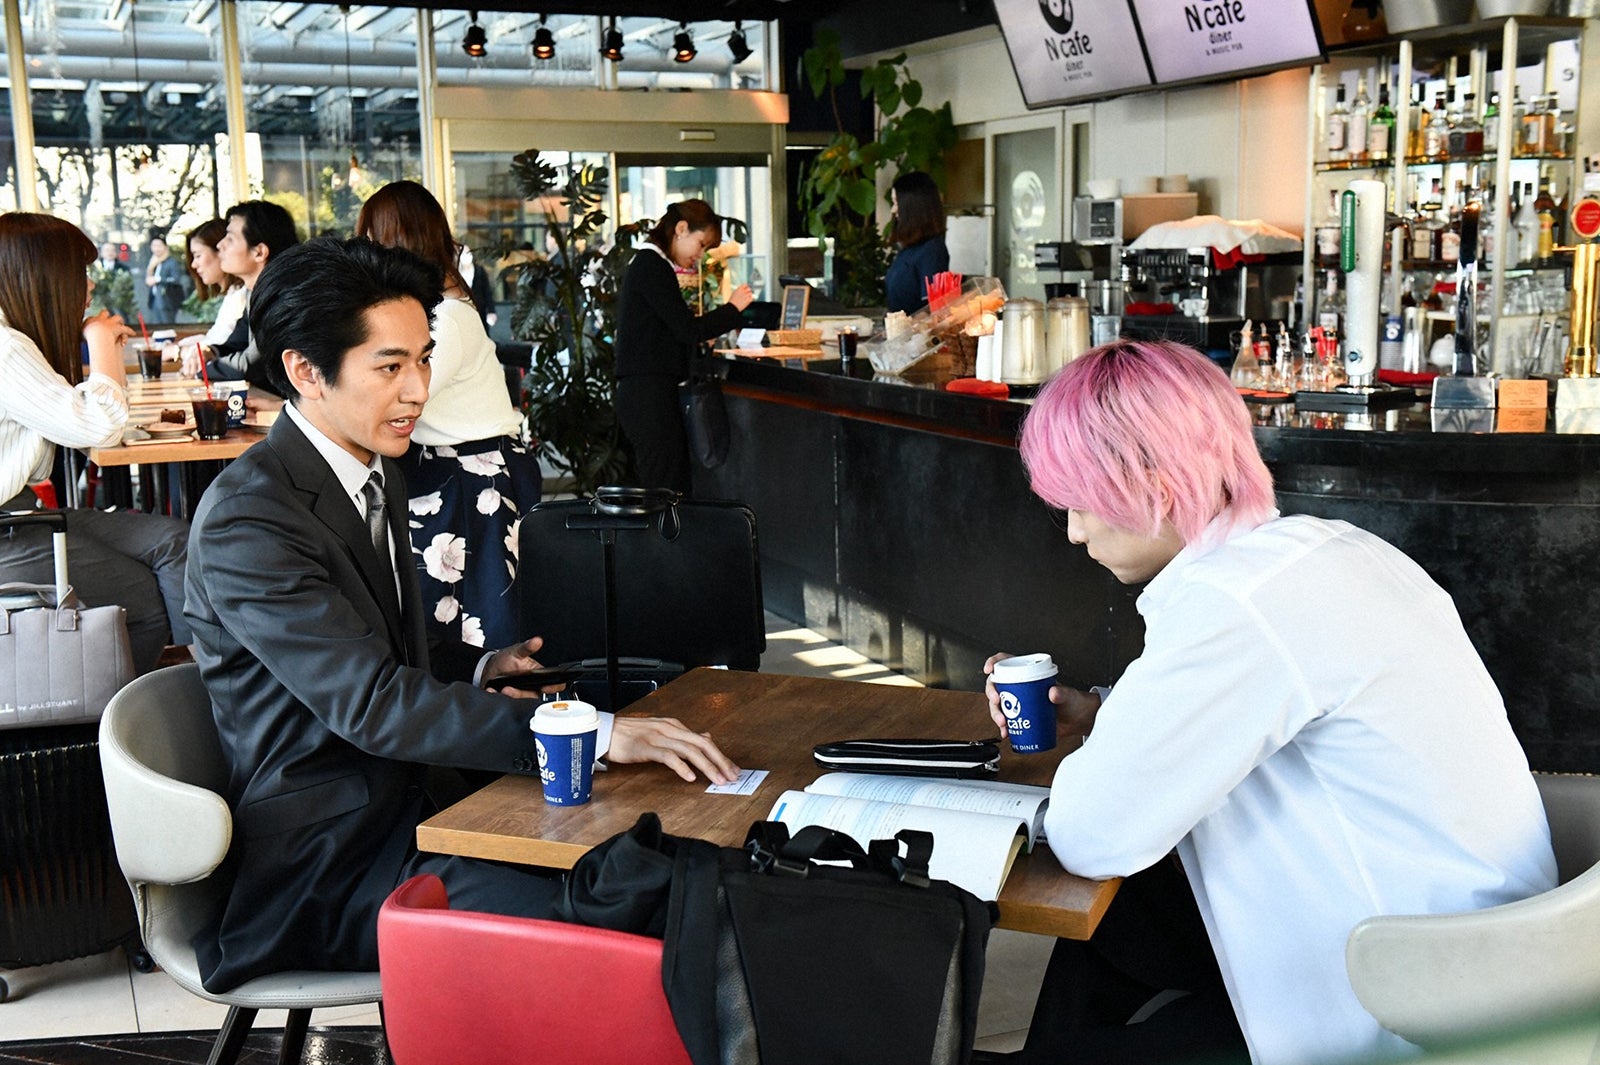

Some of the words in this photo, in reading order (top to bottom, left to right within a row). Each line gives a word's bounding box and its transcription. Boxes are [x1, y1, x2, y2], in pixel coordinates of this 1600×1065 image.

[1185, 4, 1202, 32] N
[1204, 0, 1246, 28] cafe
[1044, 37, 1060, 61] N
[1060, 30, 1093, 58] cafe
[1007, 717, 1031, 730] cafe
